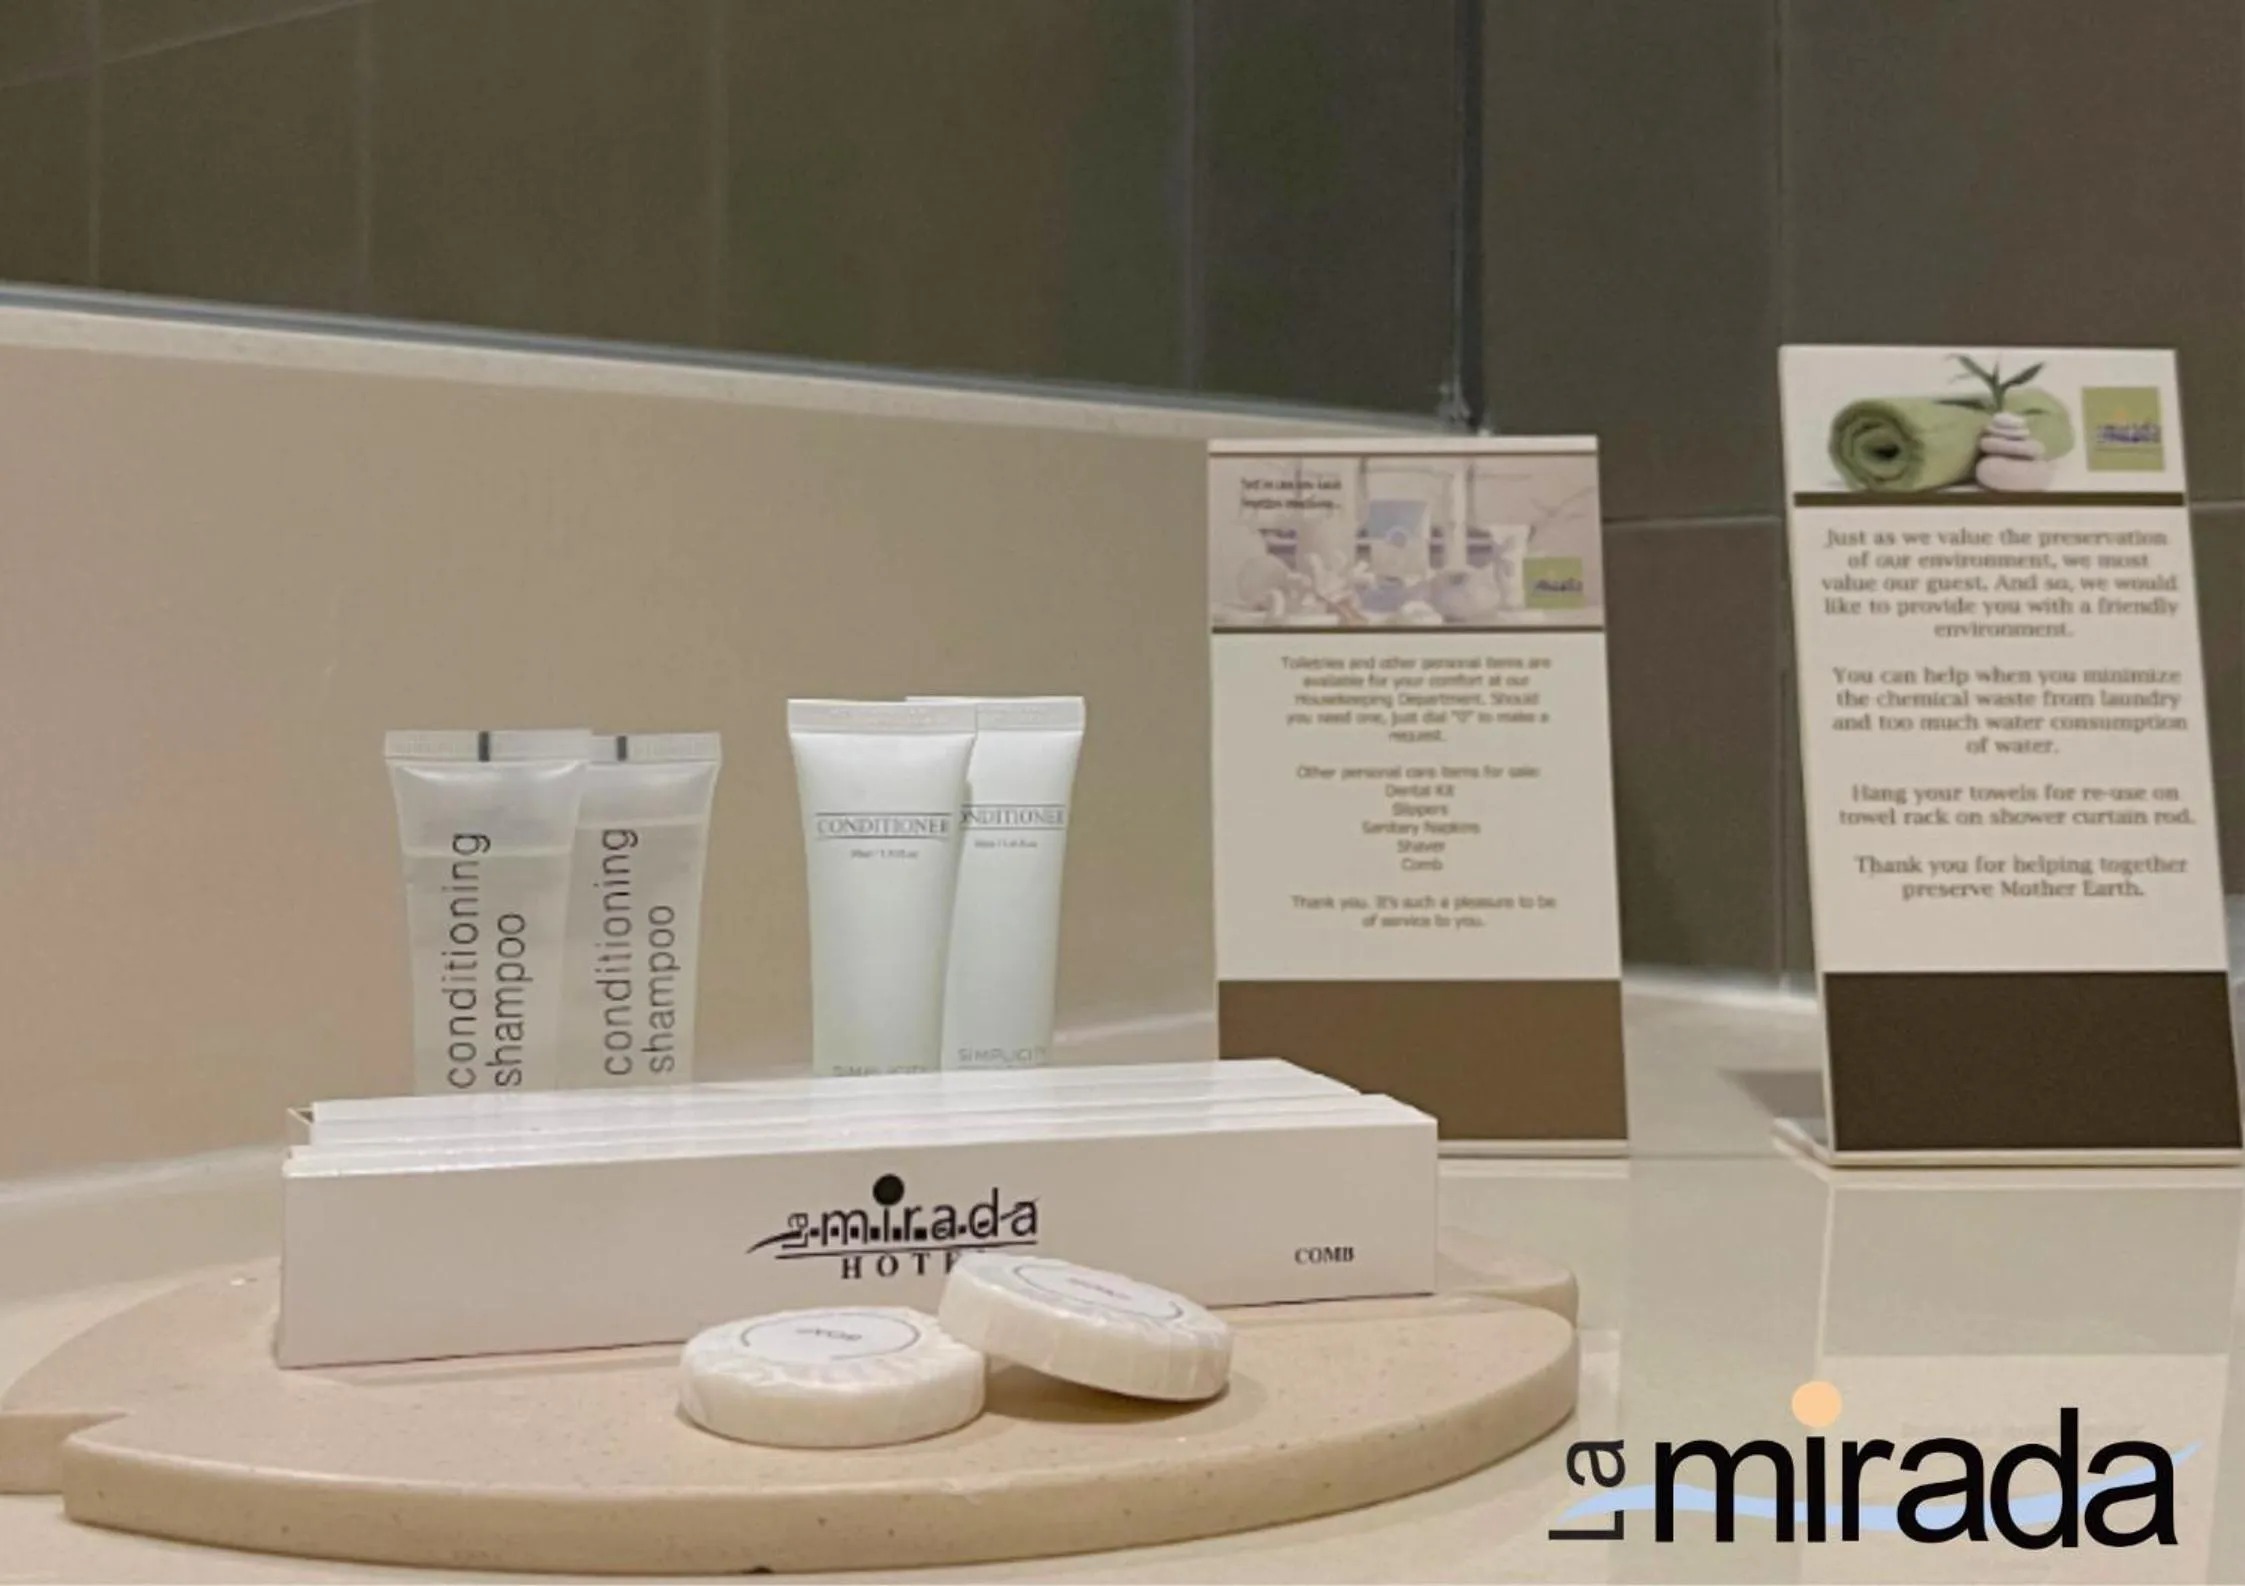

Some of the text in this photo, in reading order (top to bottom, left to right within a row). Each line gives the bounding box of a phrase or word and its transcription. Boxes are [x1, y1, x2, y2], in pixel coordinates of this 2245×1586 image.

[1825, 527, 2168, 549] Just as we value the preservation
[1848, 550, 1869, 569] of
[1875, 555, 1911, 569] our
[2062, 555, 2091, 569] we
[1822, 573, 2179, 594] value our guest. And so, we would
[1825, 596, 2179, 617] like to provide you with a friendly
[1934, 622, 2073, 638] environment.
[1349, 656, 1376, 670] and
[1379, 656, 1417, 670] other
[1421, 657, 1482, 674] personal
[1485, 656, 1524, 669] items
[1527, 658, 1551, 669] are
[1303, 673, 1530, 690] available for your comfort at our
[1832, 666, 2182, 687] You can help when you minimize
[1836, 689, 2181, 710] the chemical waste from laundry
[1286, 713, 1313, 726] you
[1317, 711, 1352, 724] need
[1391, 712, 1418, 727] just
[1422, 710, 1448, 724] dial
[1477, 712, 1493, 724] to
[1496, 711, 1536, 723] make
[1539, 713, 1550, 723] a
[1832, 713, 2188, 733] and too much water consumption
[1966, 736, 2058, 754] of water.
[1296, 765, 1336, 779] Other
[1341, 766, 1402, 780] personal
[1405, 767, 1437, 779] care
[1440, 766, 1480, 779] items
[1483, 765, 1504, 778] for
[1385, 784, 1455, 798] Dental Kit
[1852, 783, 2180, 805] Hang your towels for re-use on
[1392, 802, 1449, 818] Slippers
[1839, 807, 2195, 825] towel rack on shower curtain rod.
[1423, 820, 1480, 835] Napkins
[1397, 840, 1445, 853] Shaver
[1401, 857, 1443, 871] Comb
[1855, 855, 2188, 877] Thank you for helping together
[1902, 878, 2145, 901] preserve Mother Earth.
[1291, 895, 1334, 909] Thank
[1340, 897, 1369, 911] you.
[1401, 895, 1436, 909] such
[1440, 897, 1449, 909] a
[1454, 896, 1515, 911] pleasure
[1518, 896, 1535, 909] to
[1537, 895, 1556, 909] be
[1362, 913, 1485, 930] of service to you.
[442, 832, 491, 1089] conditioning
[594, 828, 638, 1076] conditioning
[641, 905, 681, 1074] shampoo
[485, 912, 533, 1088] shampoo
[821, 1174, 1038, 1246] mirada
[841, 1251, 962, 1279] HOTE
[1294, 1246, 1354, 1265] COMB
